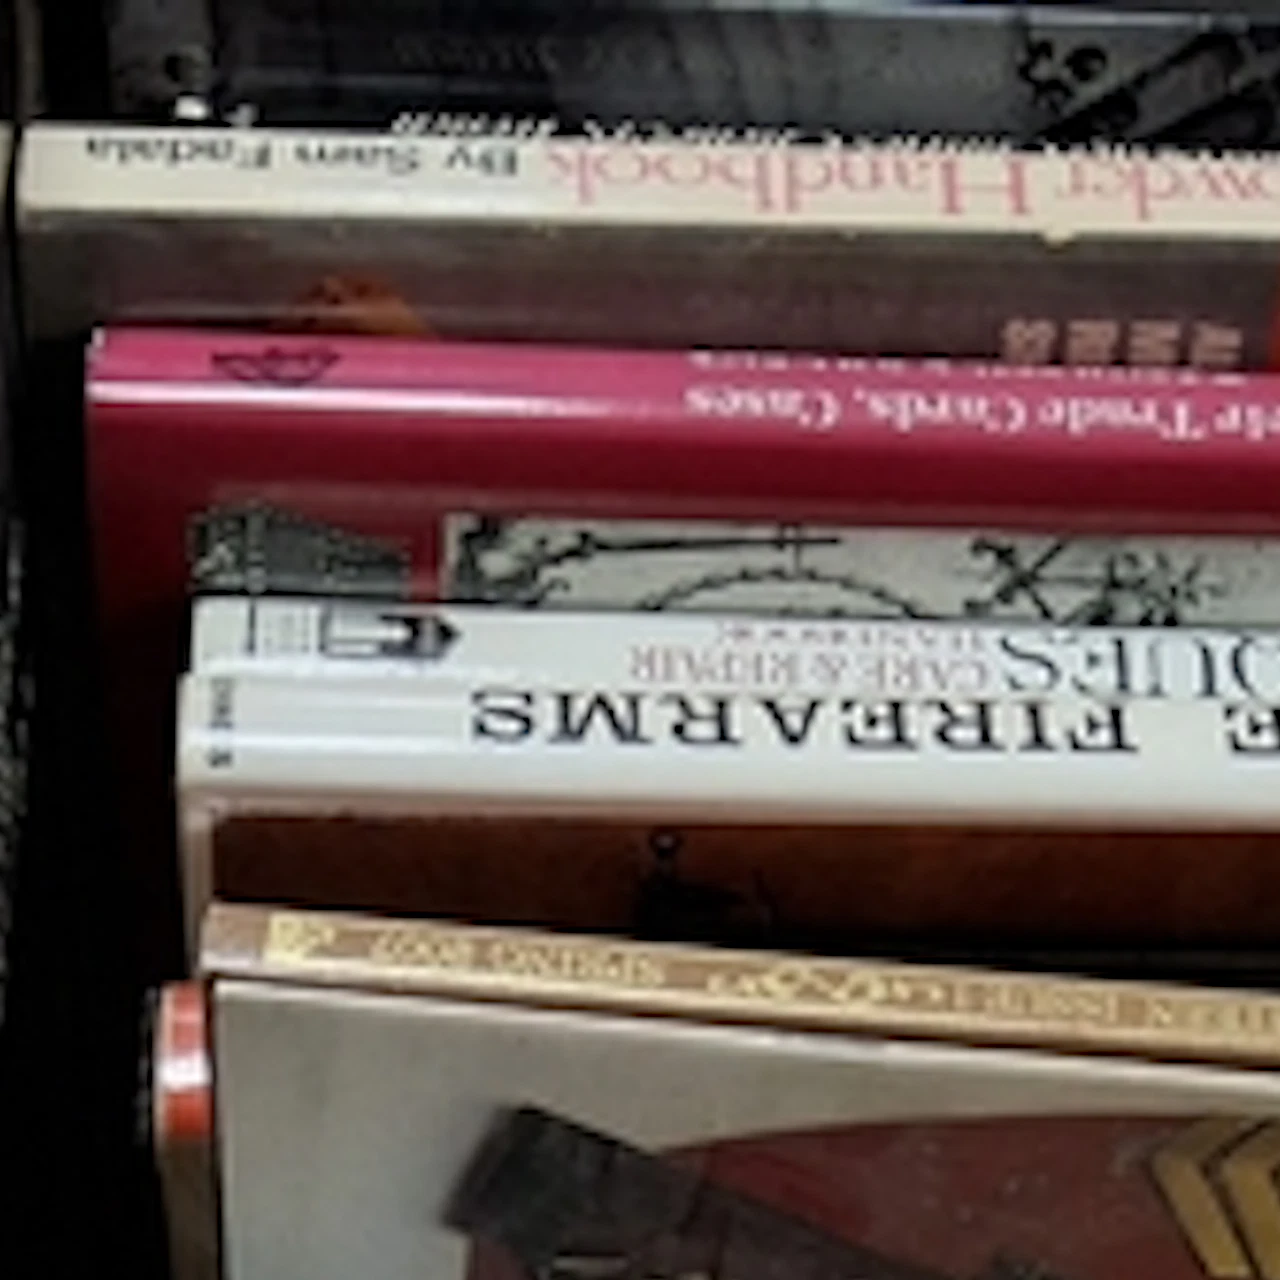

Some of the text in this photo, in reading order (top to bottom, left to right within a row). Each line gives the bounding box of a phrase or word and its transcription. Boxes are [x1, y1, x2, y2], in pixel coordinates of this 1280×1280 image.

[447, 138, 517, 175] By
[547, 150, 1052, 218] Handbook
[685, 383, 839, 430] Cases
[1039, 396, 1207, 442] Trade
[471, 687, 1138, 755] FIREARMS
